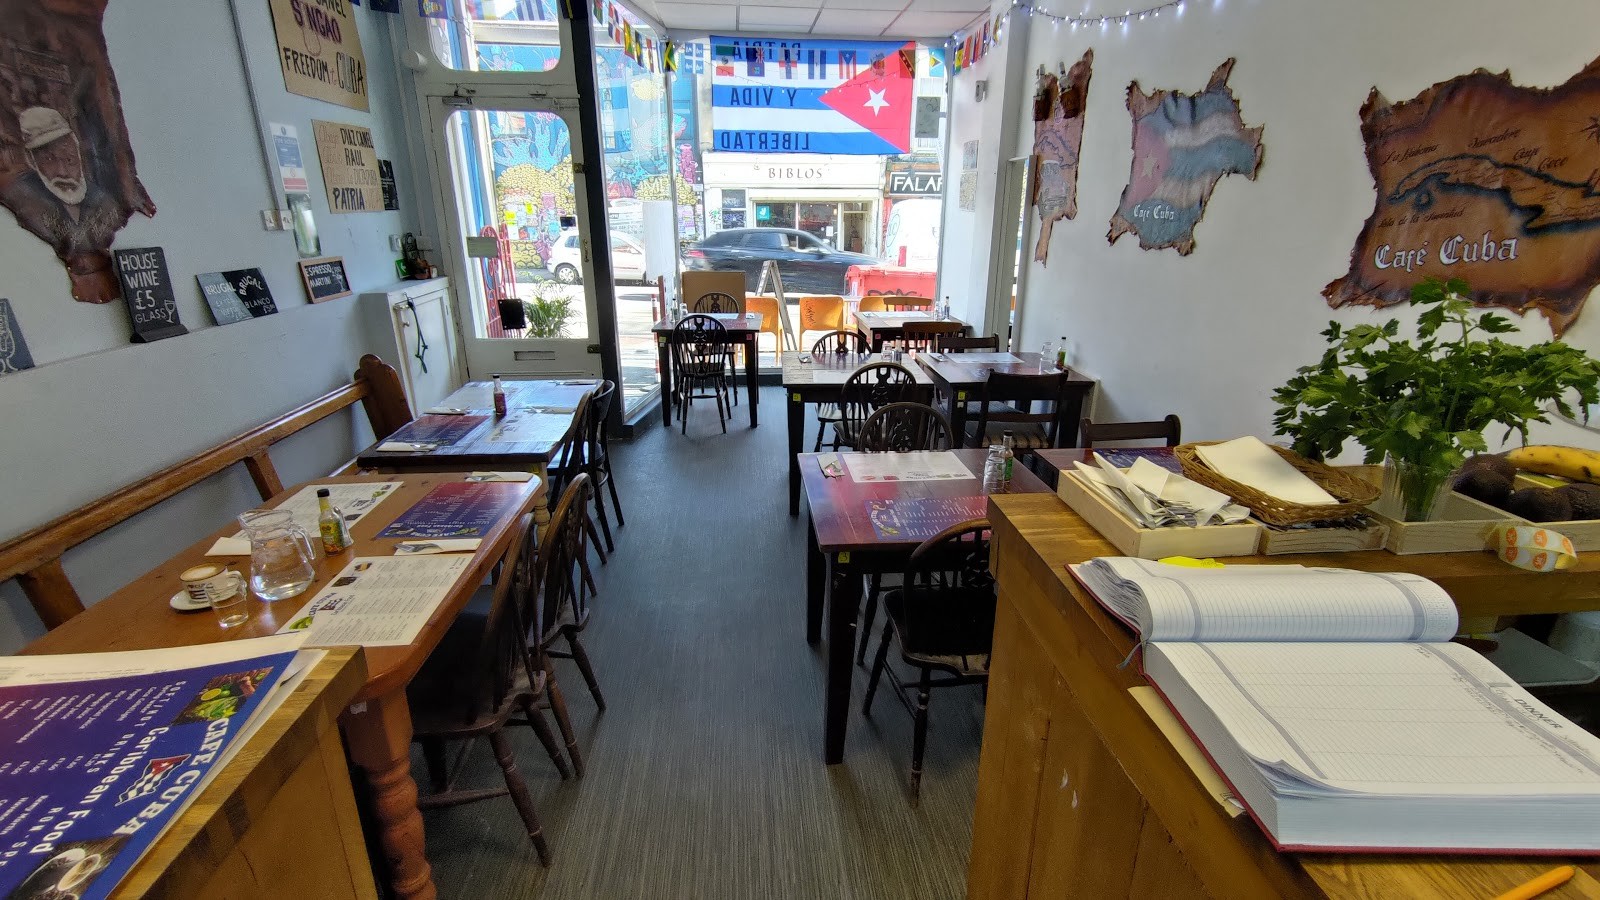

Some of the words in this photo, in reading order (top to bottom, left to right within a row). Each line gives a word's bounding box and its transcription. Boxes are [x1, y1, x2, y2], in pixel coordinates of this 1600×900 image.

[283, 46, 330, 84] FREEDOM
[336, 51, 366, 96] CUBA
[340, 127, 358, 146] DIAZ
[345, 147, 365, 167] RAUL
[768, 167, 823, 179] BIBLOS
[333, 187, 365, 210] PATRIA
[1153, 204, 1175, 220] Cuba
[119, 252, 159, 271] HOUSE
[1374, 241, 1429, 272] Café
[1439, 230, 1521, 265] Cuba
[124, 271, 160, 288] WINE
[305, 263, 332, 278] ESPRESSO
[204, 281, 236, 295] BRUGAL
[239, 275, 264, 296] BRUGAL
[135, 289, 155, 310] £5
[244, 297, 271, 309] BLANCO
[135, 308, 166, 324] GLASS
[1514, 698, 1563, 729] DINNER
[190, 717, 229, 766] CAFE
[87, 733, 135, 774] DRINKS
[80, 726, 170, 805] Caribbean
[112, 769, 200, 835] CUBA
[29, 809, 91, 854] Food
